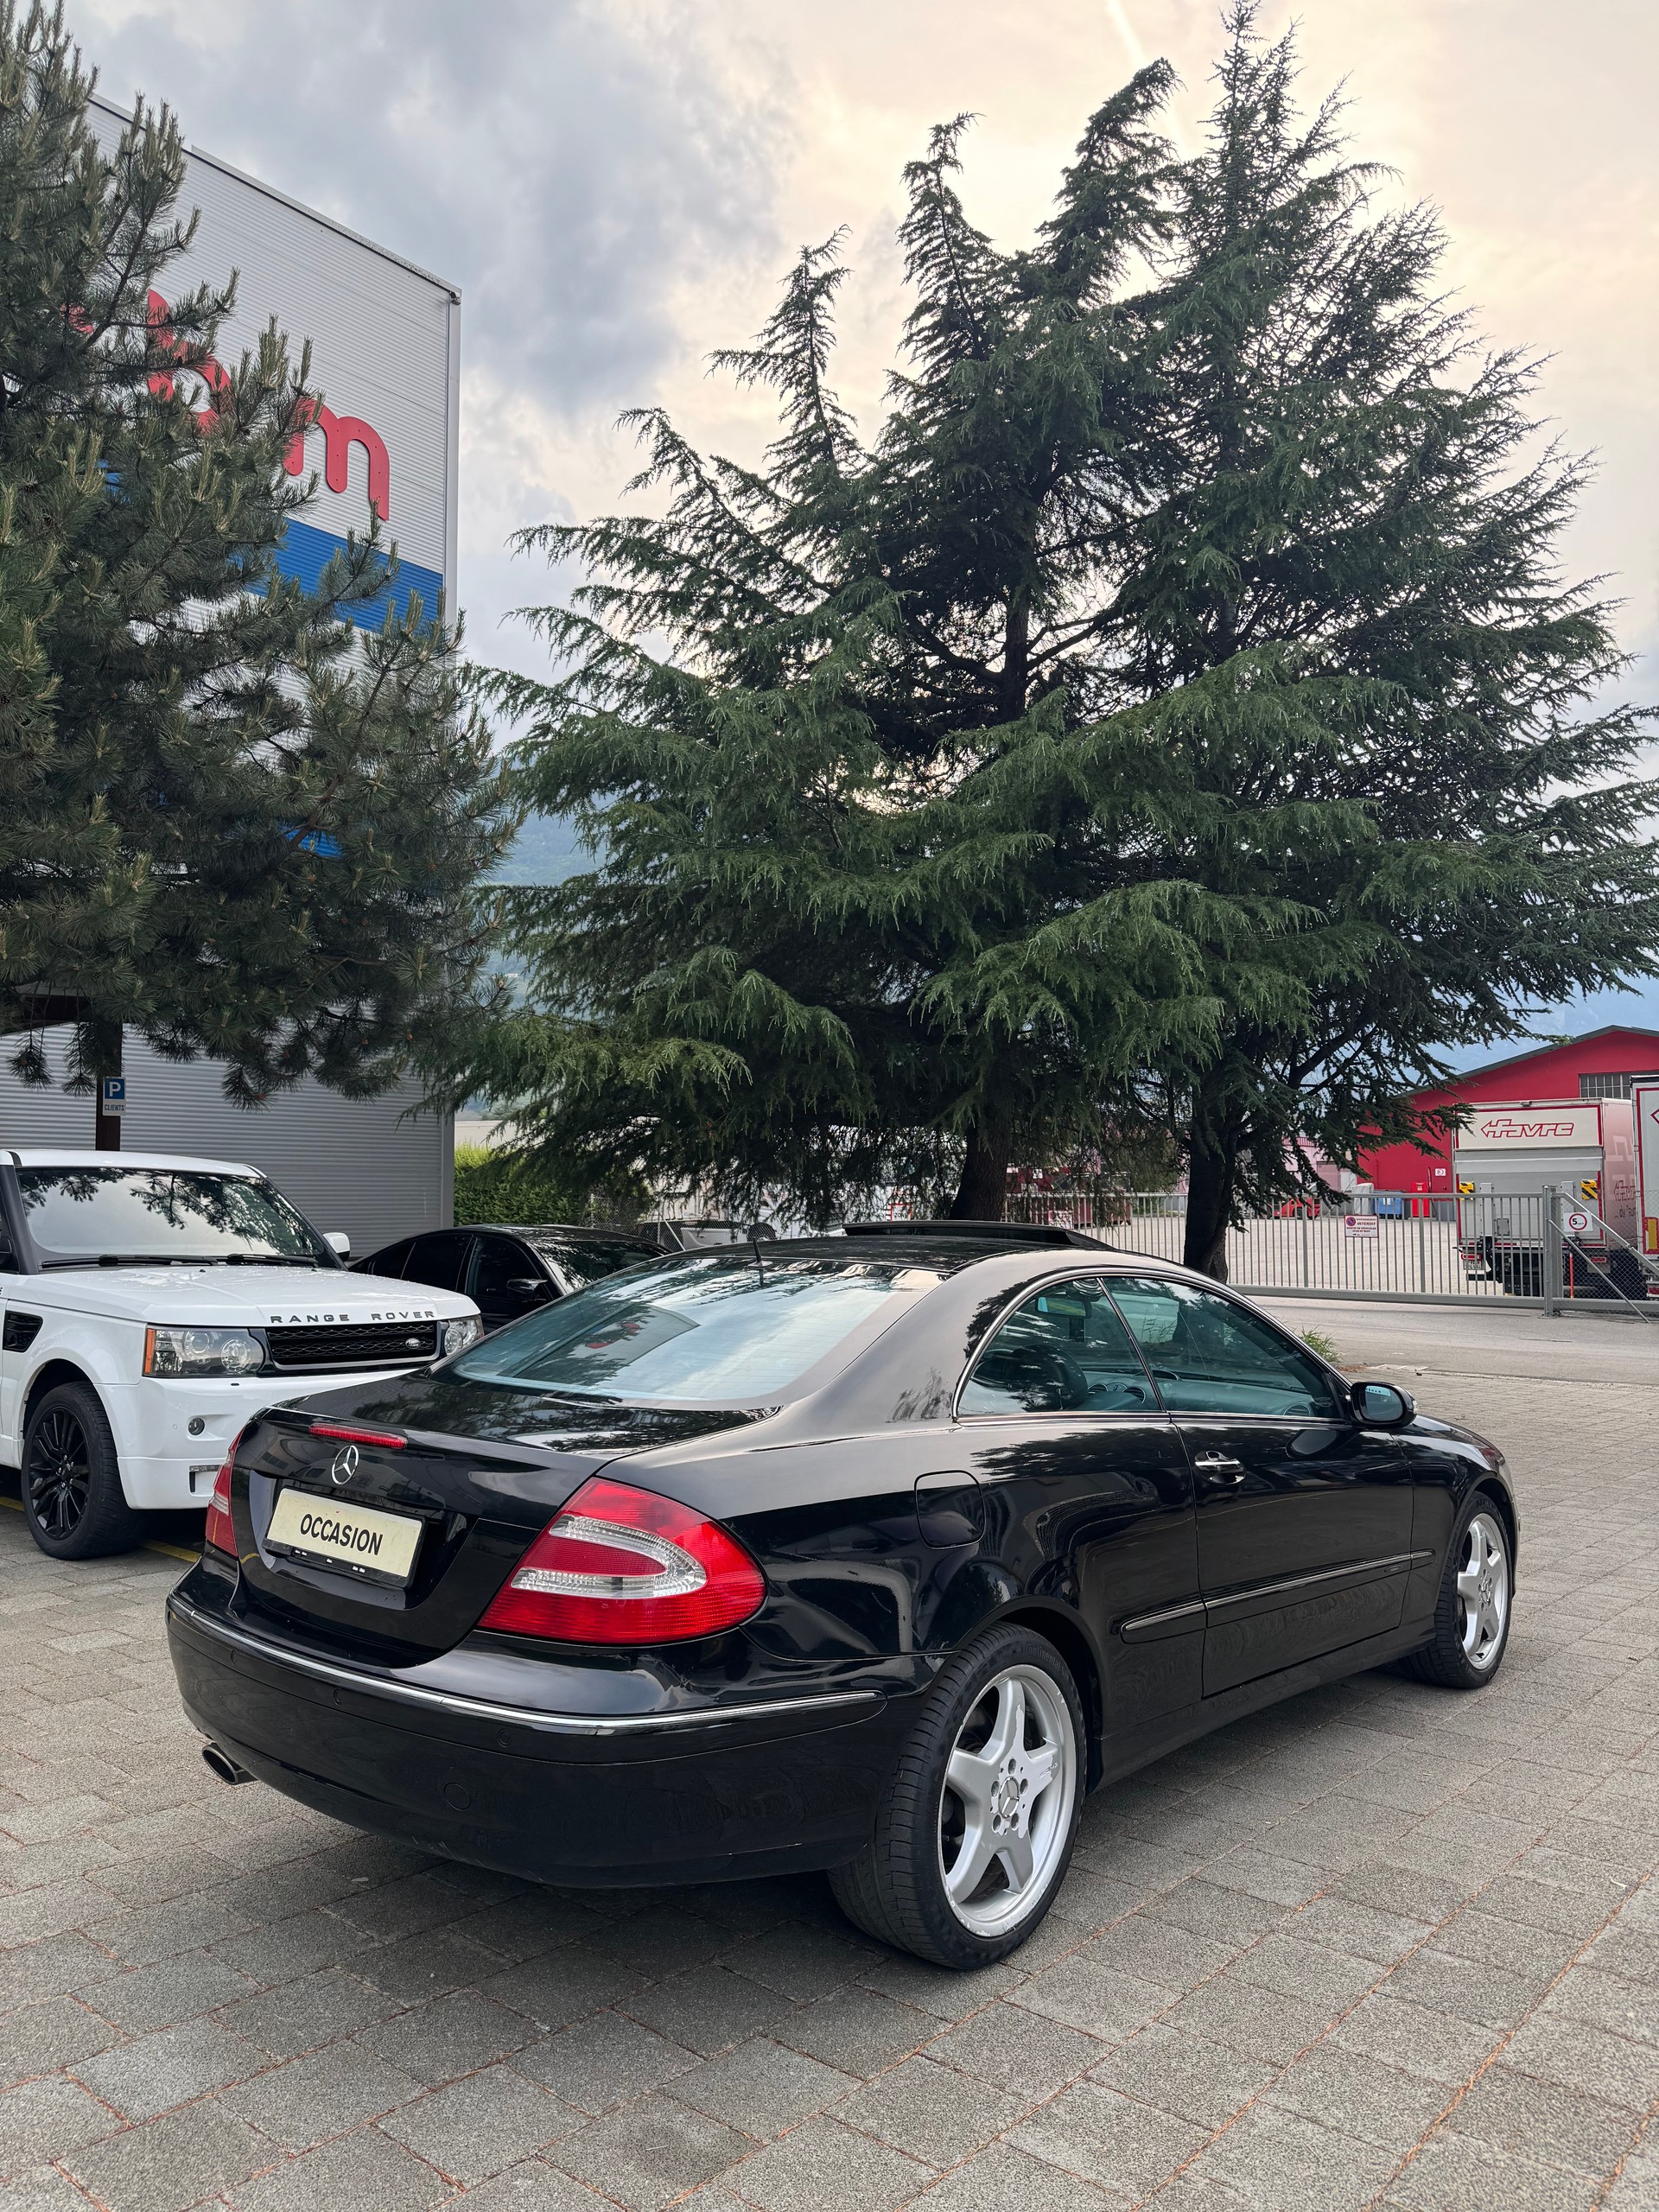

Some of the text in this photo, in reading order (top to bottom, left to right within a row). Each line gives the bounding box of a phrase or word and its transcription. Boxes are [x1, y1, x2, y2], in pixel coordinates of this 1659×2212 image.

[109, 1081, 122, 1097] P
[270, 1311, 435, 1324] RANGE ROVER
[300, 1513, 384, 1555] OCCASION
